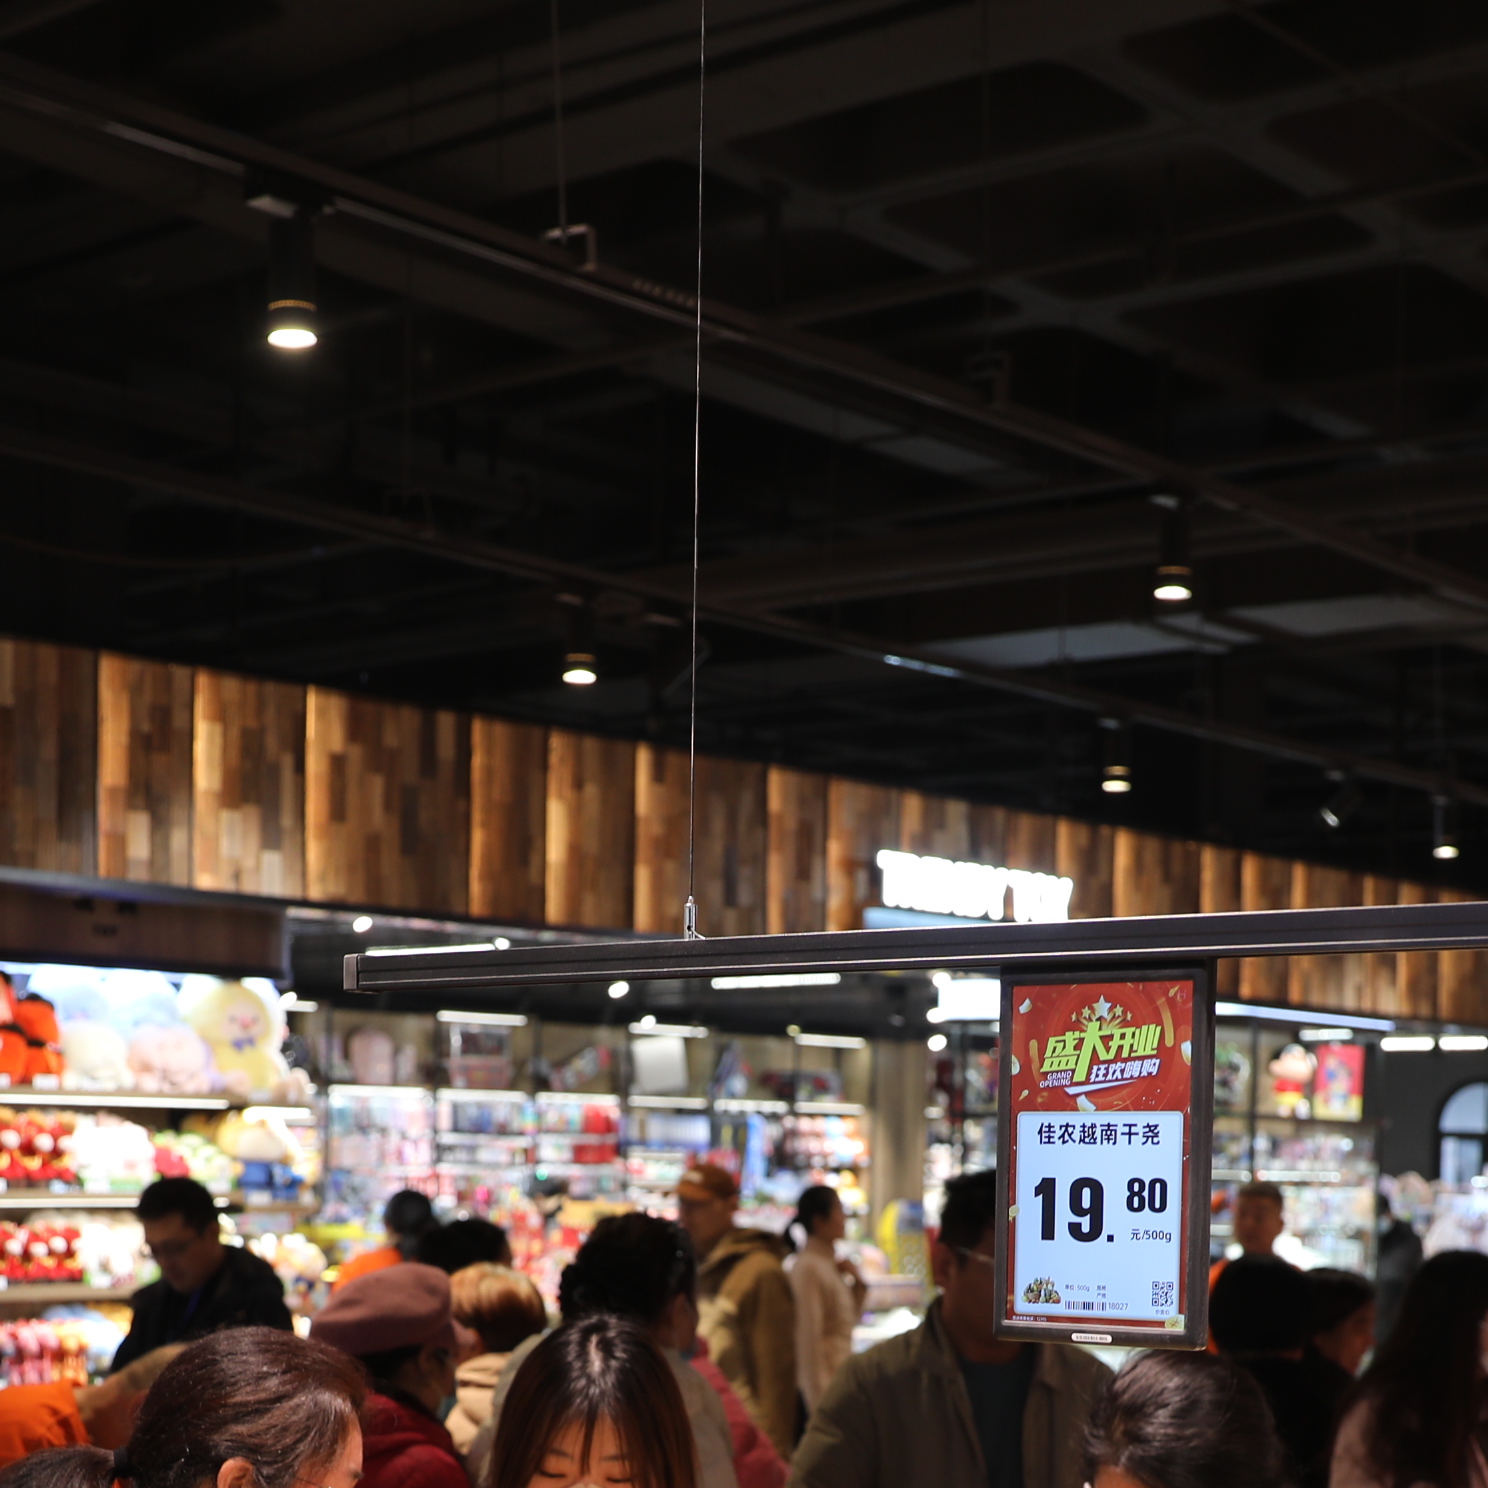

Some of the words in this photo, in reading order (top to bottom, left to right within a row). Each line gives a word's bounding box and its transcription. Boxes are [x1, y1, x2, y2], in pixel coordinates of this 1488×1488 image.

[1040, 1021, 1162, 1082] 盛大开业
[1047, 1070, 1073, 1081] GRAND
[1089, 1058, 1161, 1083] 狂欢嗨购
[1039, 1077, 1072, 1088] OPENING
[1037, 1122, 1161, 1146] 佳农越南干尧
[1126, 1177, 1168, 1213] 80
[1130, 1228, 1172, 1243] 元/500g
[1108, 1302, 1129, 1311] 18027
